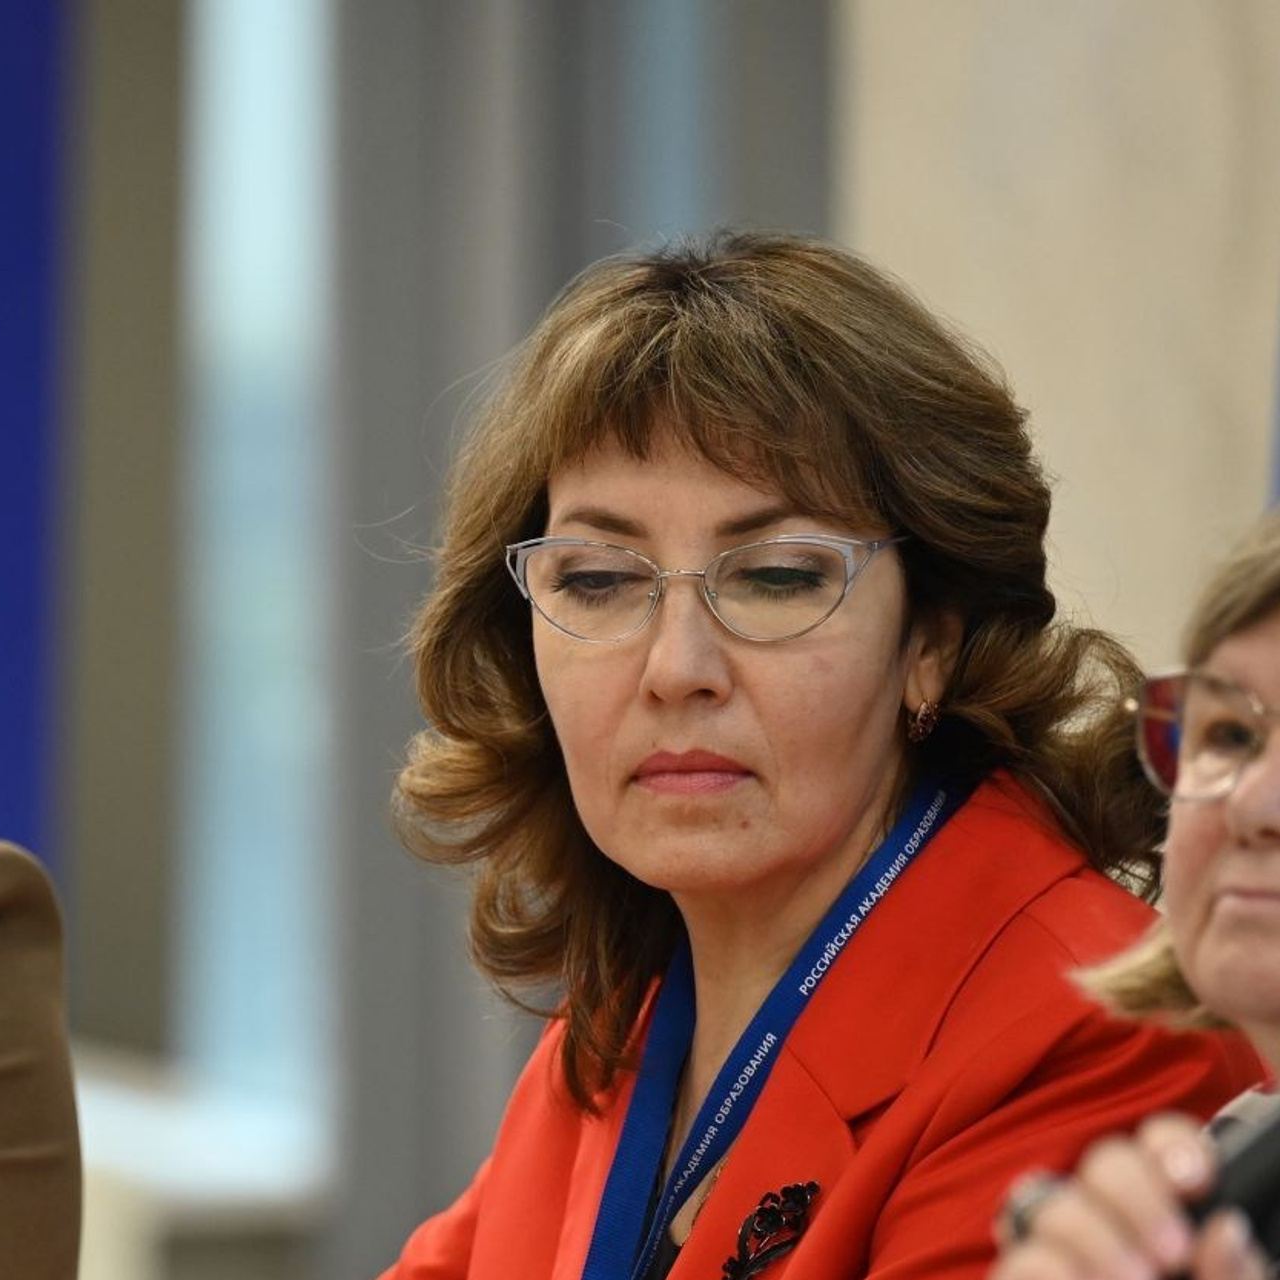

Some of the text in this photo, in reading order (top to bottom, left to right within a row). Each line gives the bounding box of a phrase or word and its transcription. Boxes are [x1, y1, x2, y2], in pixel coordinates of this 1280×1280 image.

[799, 788, 947, 996] РОССИЙСКАЯ АКАДЕМИЯ ОБРАЗОВАНИЯ
[673, 1125, 719, 1194] АКАДЕМИЯ
[714, 1031, 778, 1125] ОБРАЗОВАНИЯ
